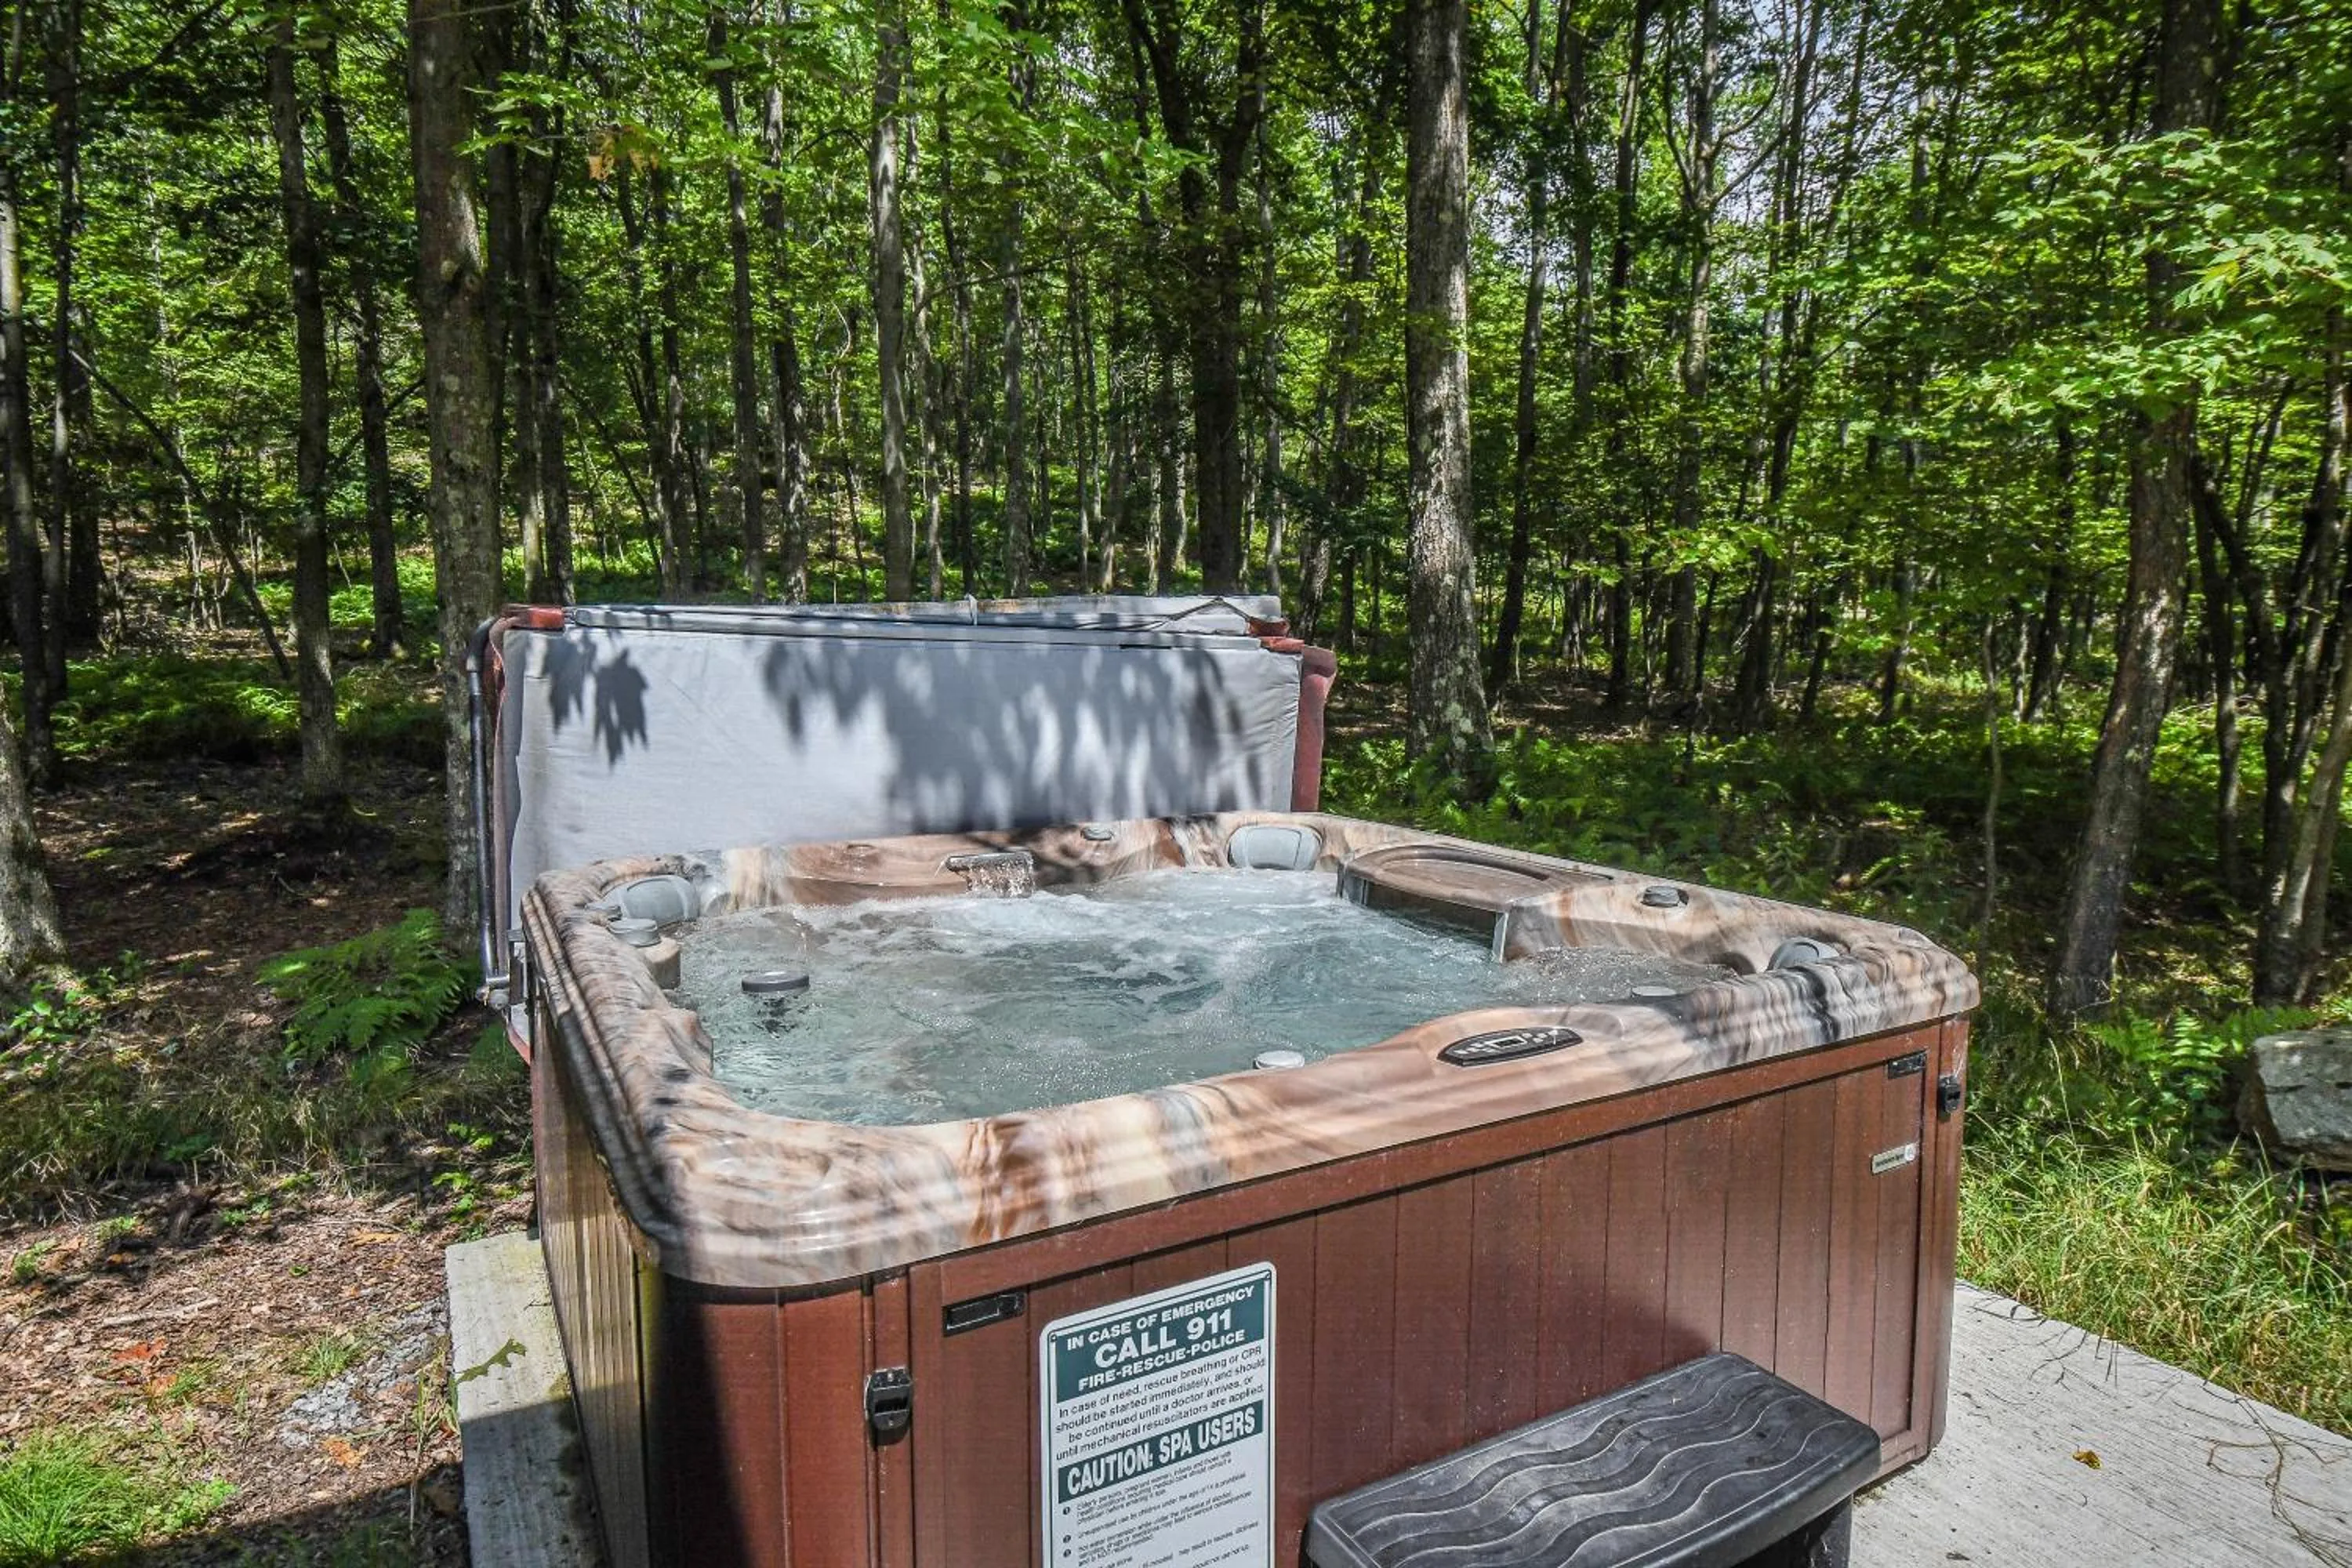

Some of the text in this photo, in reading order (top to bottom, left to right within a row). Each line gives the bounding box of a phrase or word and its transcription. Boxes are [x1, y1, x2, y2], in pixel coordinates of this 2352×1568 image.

[1067, 1285, 1254, 1351] IN CASE OF EMERGENCY
[1094, 1307, 1232, 1368] CALL 911
[1071, 1400, 1097, 1415] case
[1100, 1394, 1110, 1406] of
[1144, 1374, 1178, 1391] rescue
[1180, 1358, 1227, 1379] breathing
[1229, 1354, 1239, 1365] or
[1241, 1345, 1261, 1360] CPR
[1078, 1329, 1245, 1392] FIRE-RESCUE-POLICE
[1055, 1414, 1091, 1433] should
[1094, 1410, 1106, 1421] be
[1110, 1396, 1147, 1416] started
[1214, 1369, 1232, 1381] and
[1235, 1359, 1265, 1374] should
[1069, 1432, 1082, 1443] be
[1084, 1413, 1138, 1437] continued
[1139, 1404, 1160, 1420] until
[1171, 1392, 1204, 1409] doctor
[1056, 1445, 1078, 1461] until
[1080, 1423, 1141, 1453] mechanical
[1142, 1404, 1208, 1432] resuscitators
[1210, 1398, 1226, 1409] are
[1067, 1441, 1153, 1495] CAUTION:
[1159, 1428, 1192, 1464] SPA
[1197, 1406, 1255, 1450] USERS
